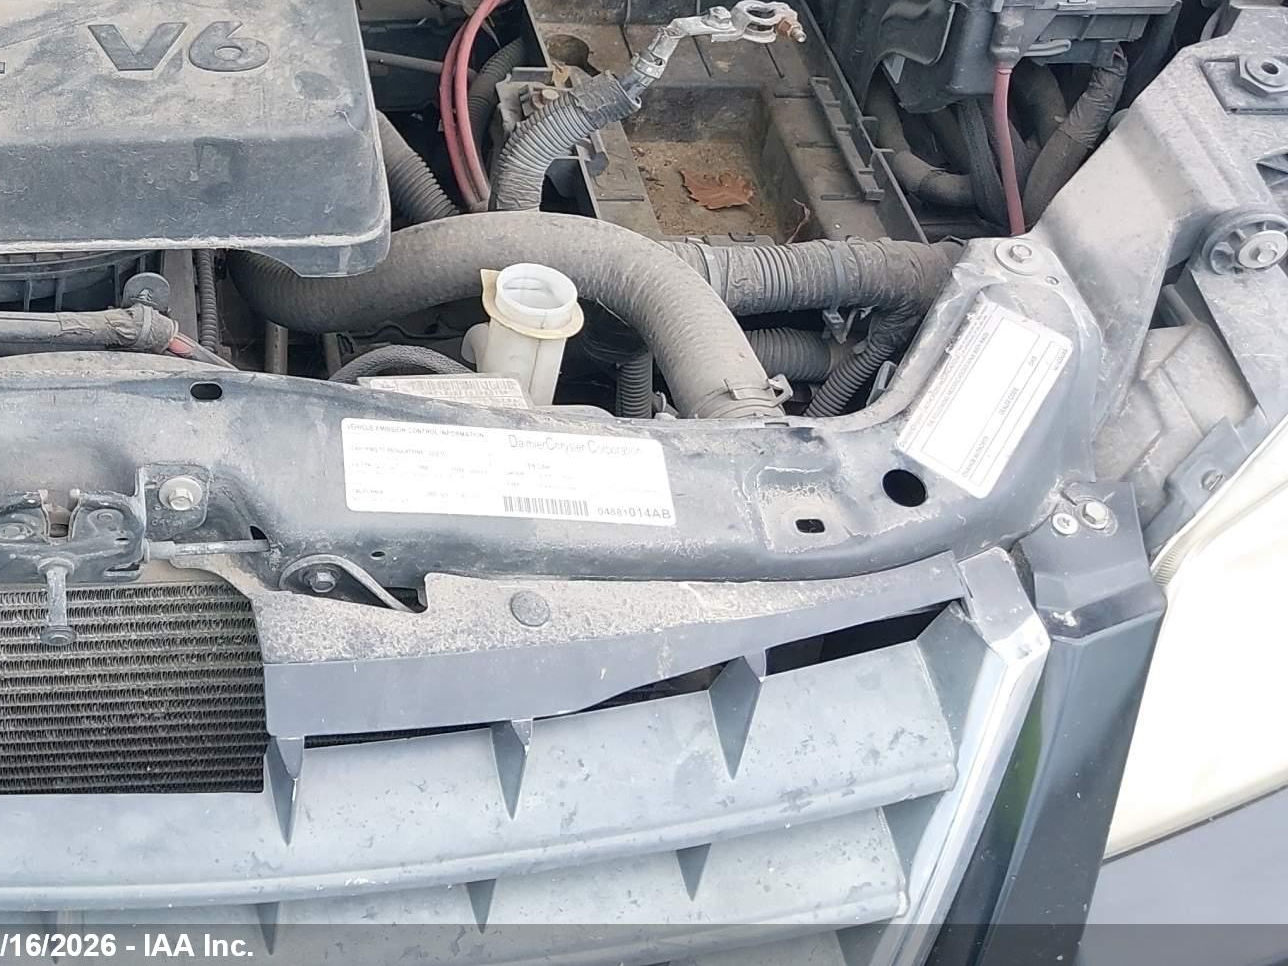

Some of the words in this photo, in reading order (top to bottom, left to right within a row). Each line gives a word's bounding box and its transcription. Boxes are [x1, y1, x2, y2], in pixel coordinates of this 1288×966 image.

[88, 20, 271, 73] V6
[346, 423, 374, 431] VEHICLE
[375, 425, 406, 433] EMISSION
[408, 427, 438, 436] CONTROL
